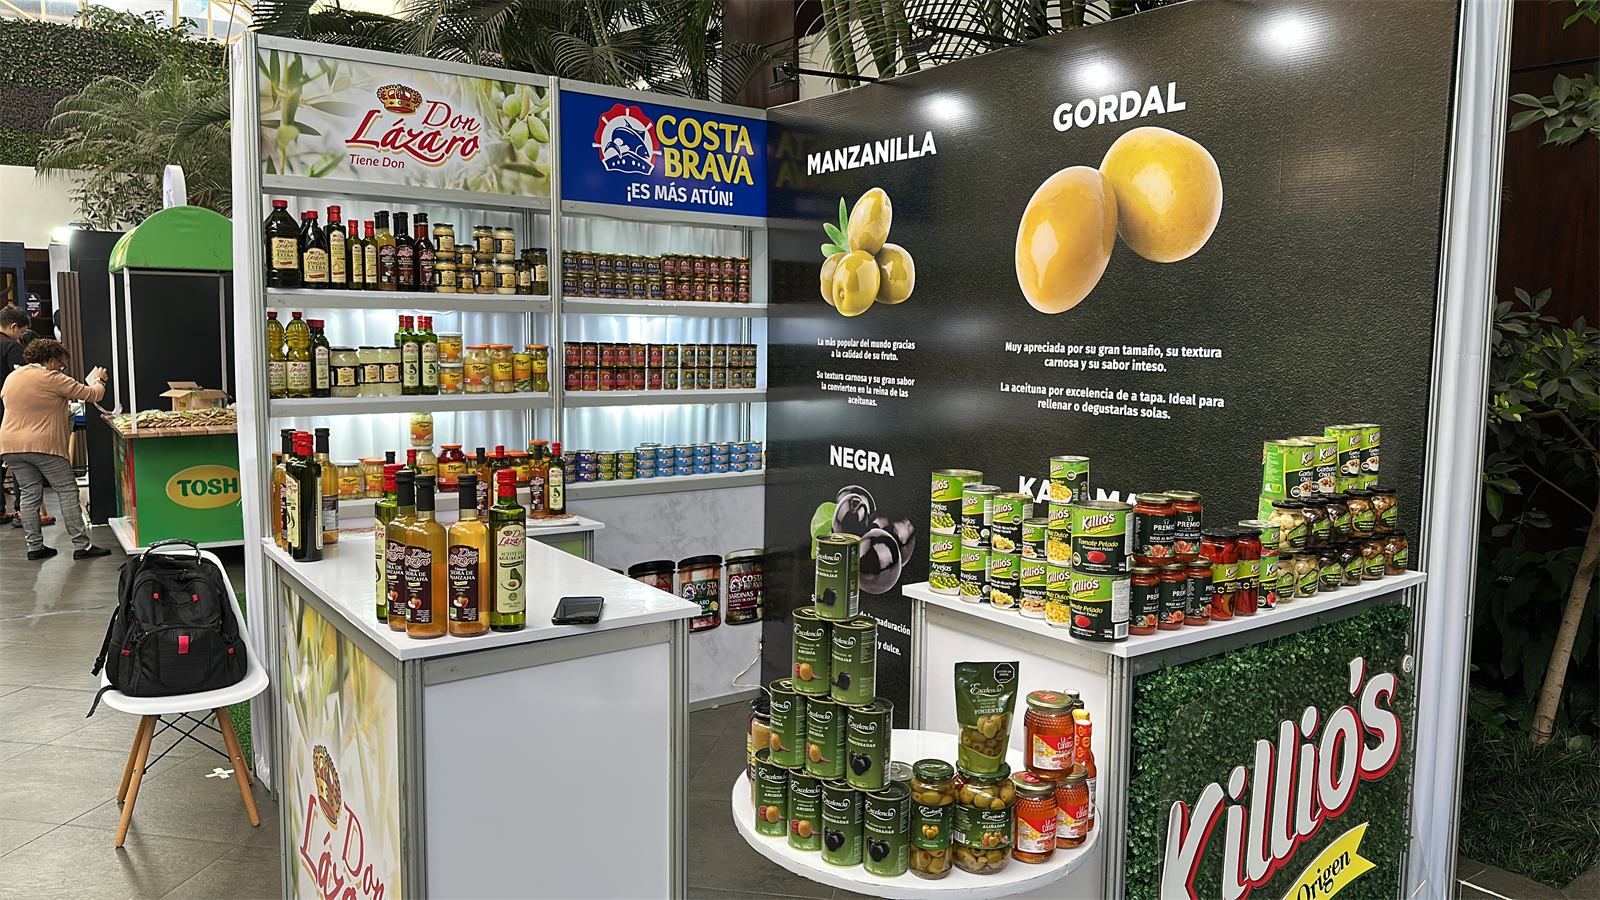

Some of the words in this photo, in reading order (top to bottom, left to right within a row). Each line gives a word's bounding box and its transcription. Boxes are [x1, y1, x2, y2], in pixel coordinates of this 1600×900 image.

[422, 100, 481, 130] Don
[1052, 82, 1186, 132] GORDAL
[344, 109, 480, 165] Lázaro
[656, 115, 754, 156] COSTA
[349, 154, 379, 167] Tiene
[382, 156, 405, 169] Don
[807, 131, 937, 175] MANZANILLA
[663, 147, 754, 185] BRAVA
[627, 182, 650, 202] ¡ES
[654, 182, 687, 203] MÁS
[691, 186, 733, 206] ATÚN!
[818, 338, 824, 346] La
[825, 338, 836, 346] más
[837, 338, 859, 348] popular
[860, 339, 869, 347] del
[871, 340, 891, 349] mundo
[892, 340, 915, 350] gracias
[1005, 342, 1022, 354] Muy
[1023, 342, 1066, 354] apreciada
[1067, 346, 1083, 356] por
[1085, 346, 1096, 354] su
[1098, 346, 1120, 357] gran
[1122, 345, 1164, 358] tamaño,
[1166, 347, 1178, 356] su
[1181, 347, 1222, 358] textura
[836, 350, 841, 358] la
[842, 350, 863, 359] calidad
[864, 351, 871, 359] de
[873, 352, 879, 360] su
[881, 351, 898, 360] fruto.
[1044, 359, 1079, 368] carnosa
[1080, 360, 1087, 370] y
[1089, 360, 1100, 369] su
[1102, 359, 1130, 370] sabor
[1132, 359, 1167, 372] inteso.
[825, 371, 844, 380] textura
[845, 374, 867, 382] carnosa
[868, 376, 872, 384] y
[873, 376, 880, 384] su
[882, 377, 896, 386] gran
[897, 376, 915, 386] sabor
[821, 382, 826, 390] la
[828, 383, 856, 393] convierten
[858, 386, 865, 394] en
[866, 386, 872, 394] la
[873, 386, 888, 396] reina
[890, 388, 897, 396] de
[899, 388, 908, 397] las
[1000, 382, 1009, 392] La
[1011, 383, 1046, 394] aceituna
[1049, 387, 1064, 397] por
[1066, 387, 1114, 400] excelencia
[1116, 389, 1129, 400] de
[1131, 393, 1137, 401] a
[1140, 392, 1166, 405] tapa.
[1169, 393, 1196, 406] Ideal
[1199, 397, 1224, 408] para
[848, 396, 878, 406] aceitunas.
[1038, 399, 1072, 410] rellenar
[1074, 403, 1080, 411] o
[1082, 402, 1138, 416] degustarlas
[1140, 406, 1171, 419] solas.
[830, 444, 895, 476] NEGRA
[177, 477, 238, 497] TOSH
[1082, 512, 1116, 531] Killio's
[1078, 538, 1098, 547] Tomate
[1098, 540, 1118, 548] Pelado
[729, 591, 754, 599] SARDINAS
[1072, 578, 1099, 594] Killio's
[1083, 605, 1103, 614] Pelado
[874, 617, 910, 636] maduración
[878, 641, 883, 650] y
[883, 642, 901, 655] dulce.
[848, 714, 877, 734] Excelencia
[1160, 656, 1401, 900] Killio's
[865, 800, 896, 821] Excelencia
[1296, 851, 1350, 900] Origen
